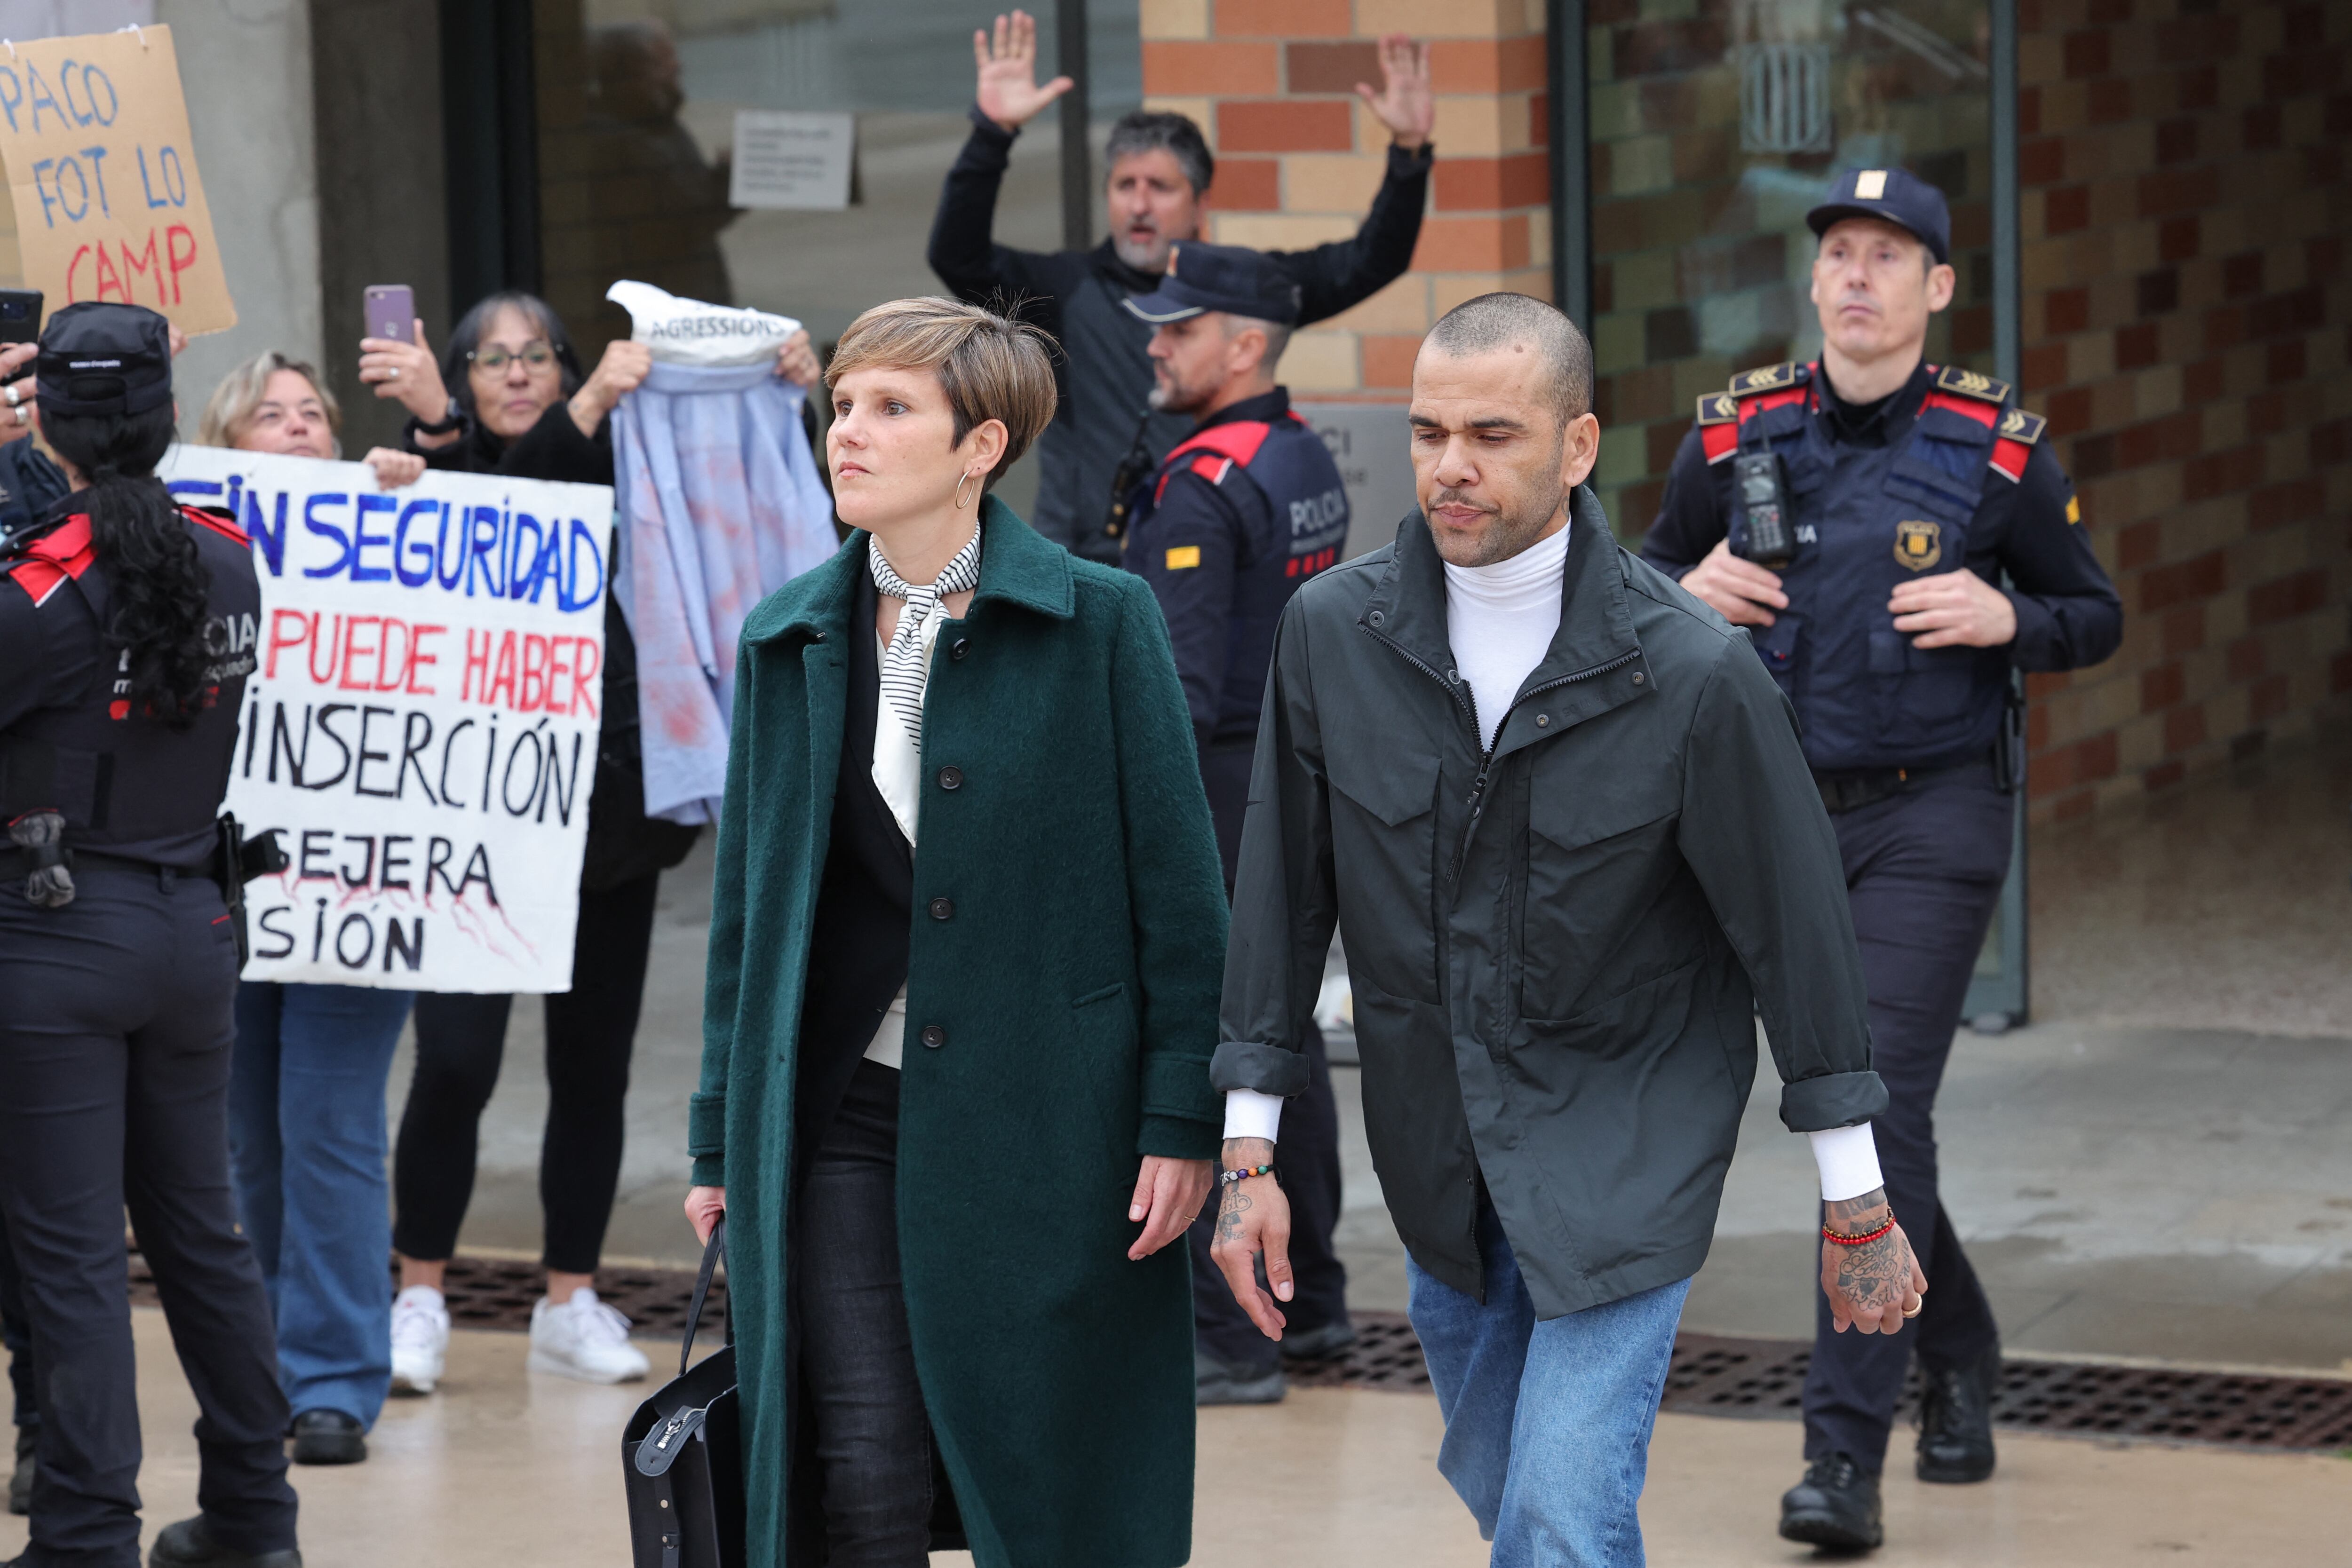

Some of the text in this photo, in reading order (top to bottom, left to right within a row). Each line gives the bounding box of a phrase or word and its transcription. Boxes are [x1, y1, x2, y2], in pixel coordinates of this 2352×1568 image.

[0, 59, 118, 135] PACO
[32, 143, 186, 229] FOT LO
[67, 222, 197, 307] CAMP
[264, 608, 447, 695] PUEDE
[460, 627, 601, 720] HABER
